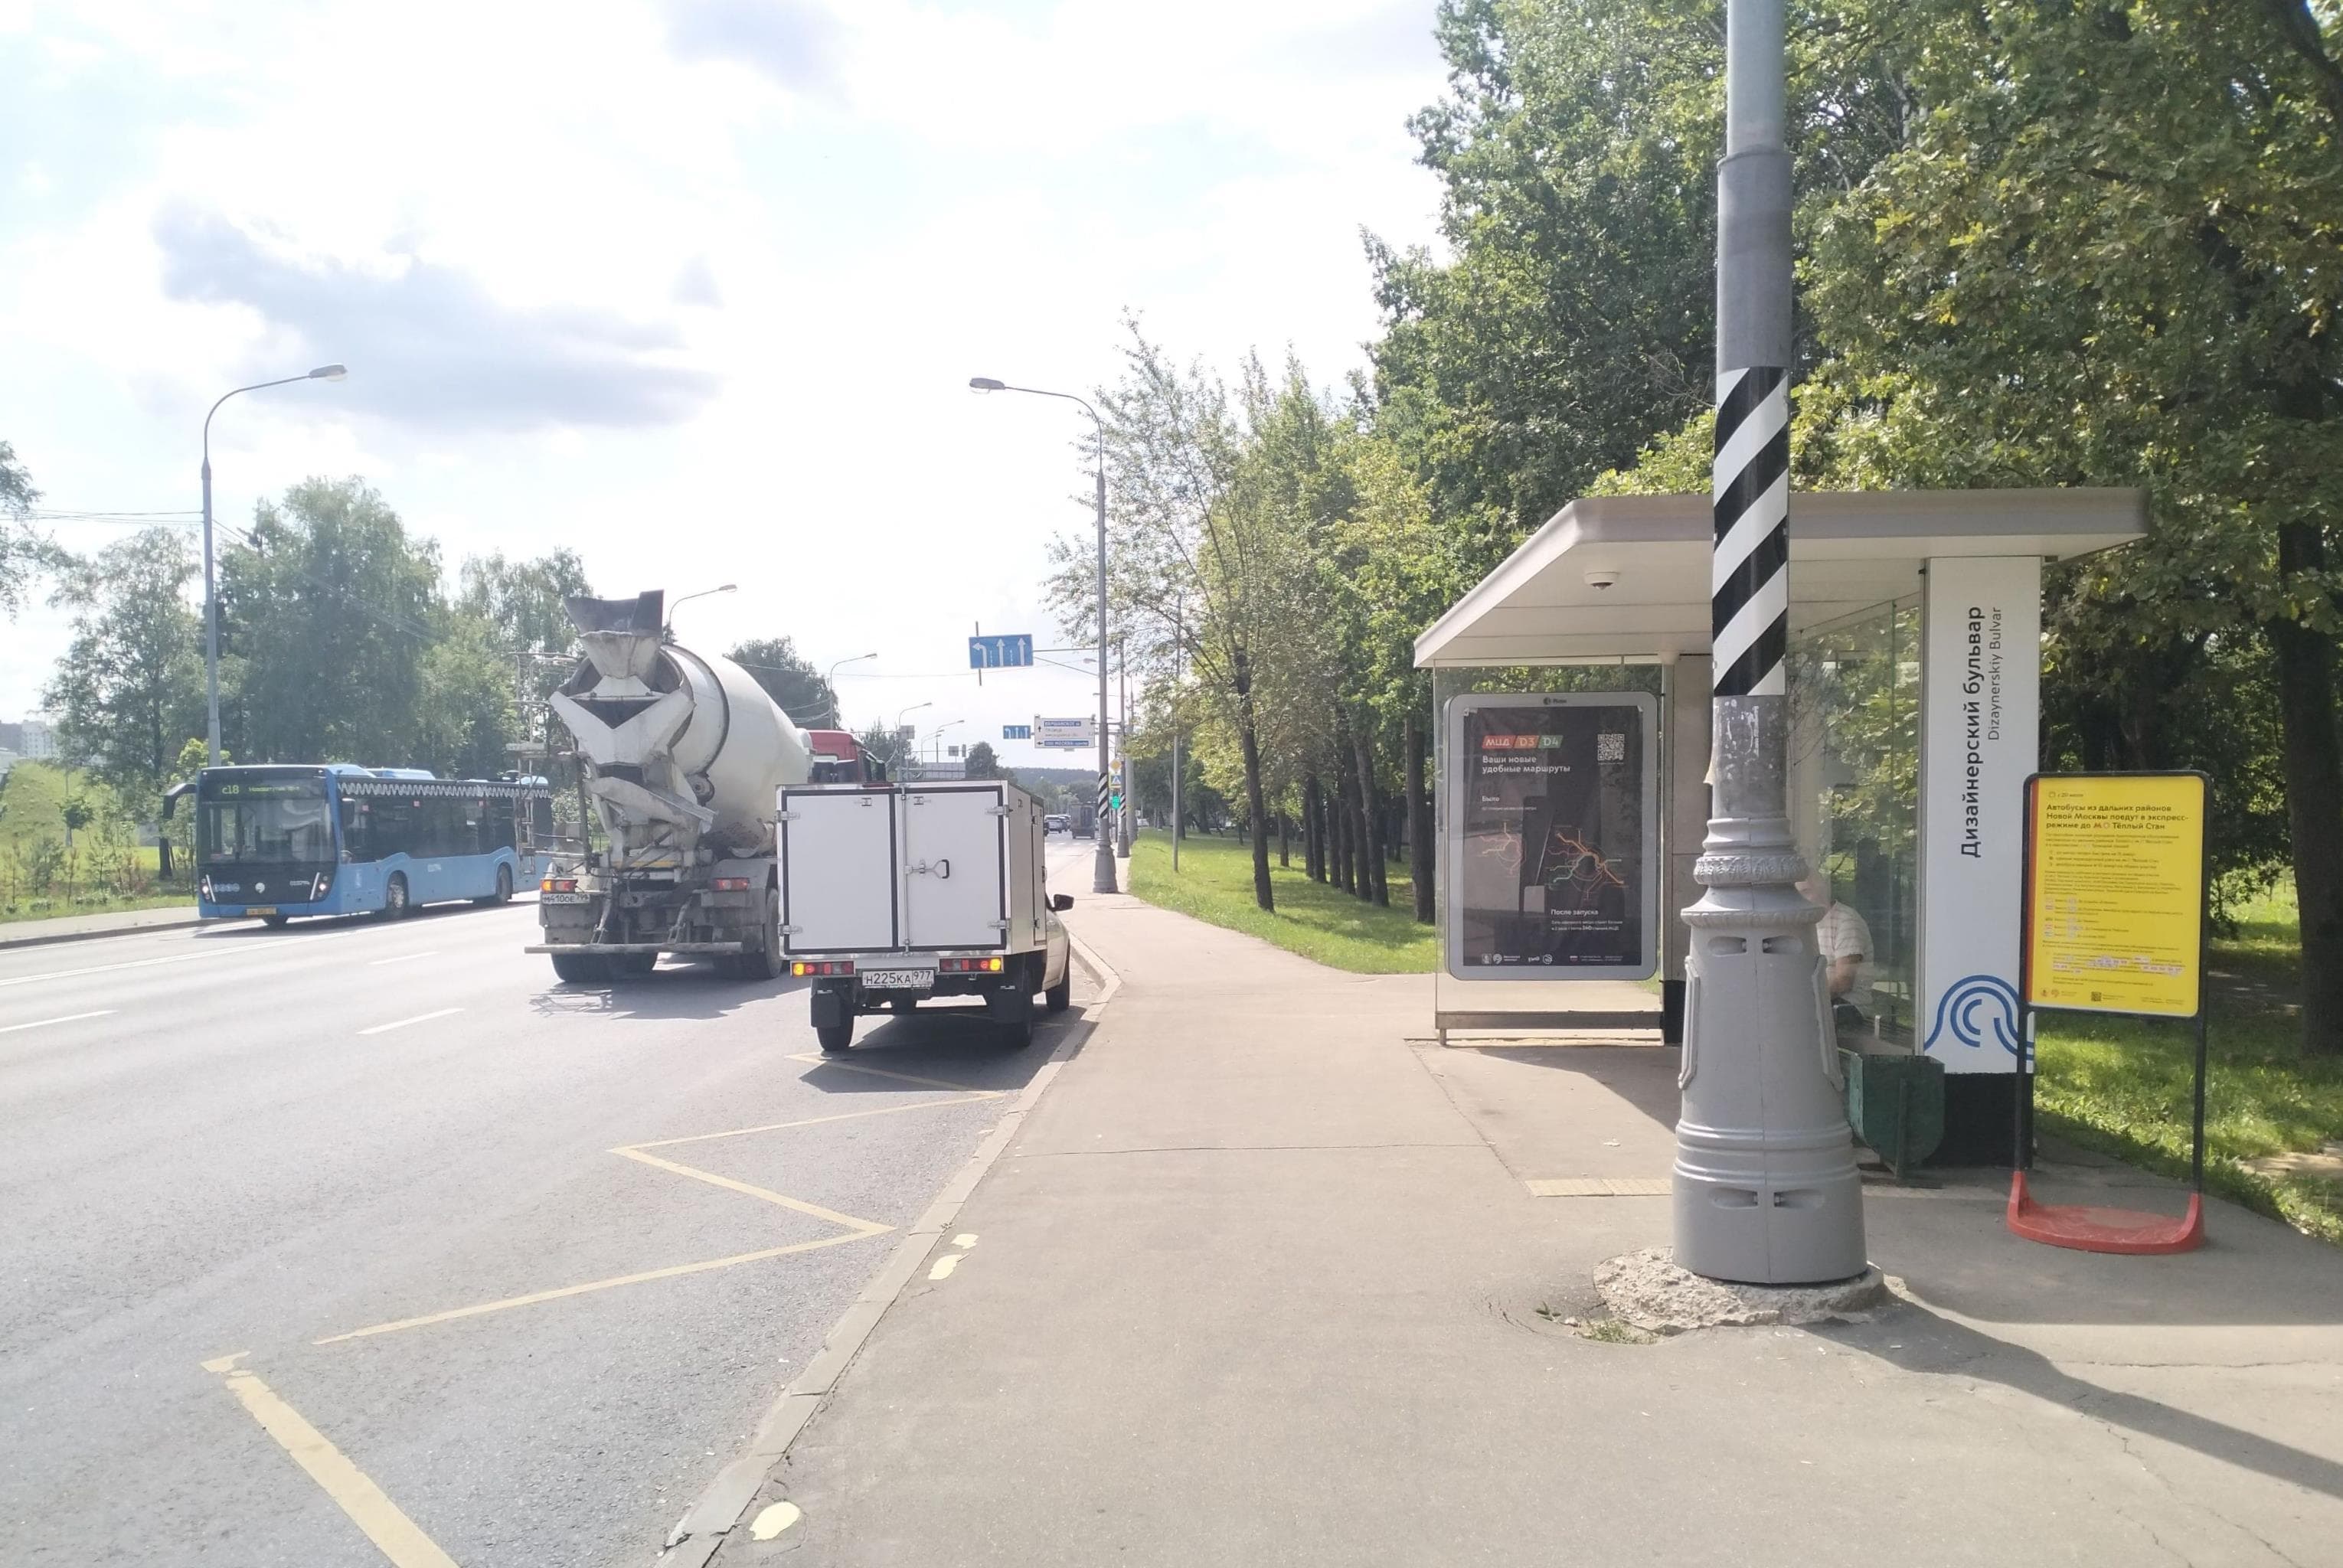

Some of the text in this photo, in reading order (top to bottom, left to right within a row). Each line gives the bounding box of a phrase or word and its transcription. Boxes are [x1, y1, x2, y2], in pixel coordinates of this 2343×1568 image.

[1988, 607, 2003, 740] Dizaynerskiy Bulvar
[1962, 606, 1985, 858] Дизайнерский бульвар
[1519, 738, 1535, 746] D3
[1543, 737, 1558, 746] D4
[1482, 766, 1570, 774] удобные маршруты
[2047, 805, 2085, 813] Автобусы
[2113, 822, 2143, 830] Тёплый
[1573, 909, 1599, 917] запуска
[866, 971, 930, 985] Н225КА 977
